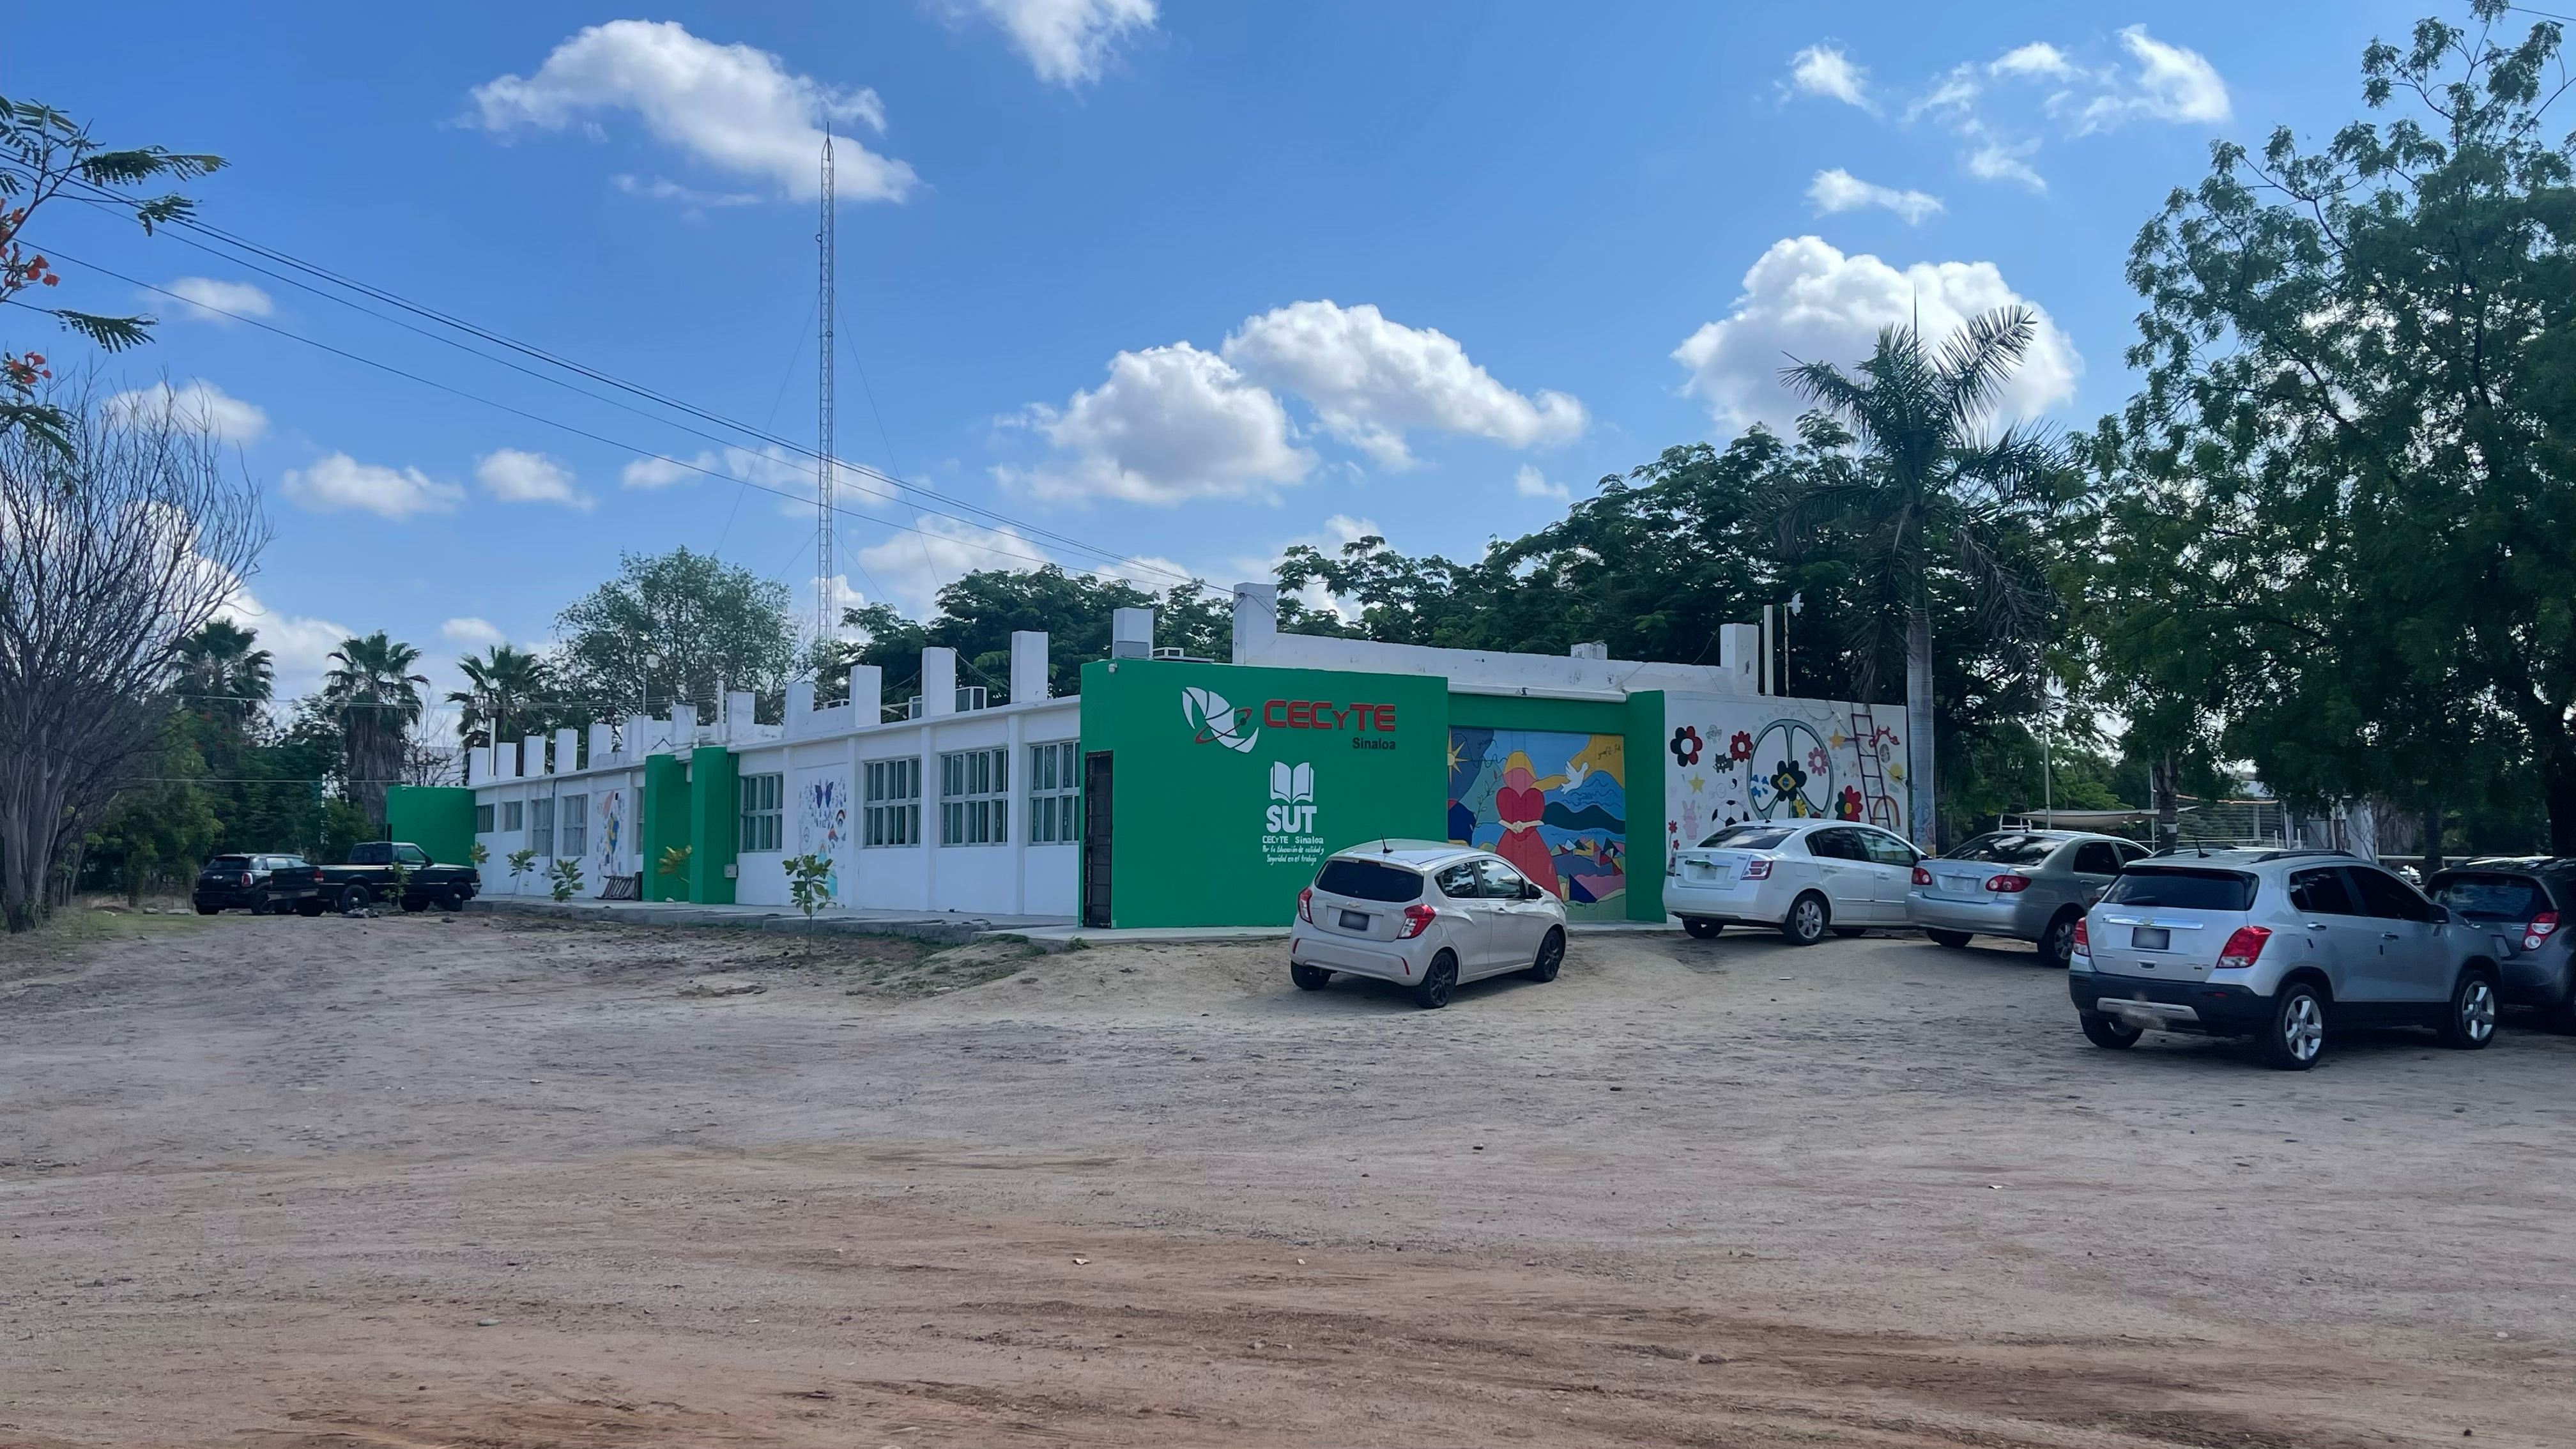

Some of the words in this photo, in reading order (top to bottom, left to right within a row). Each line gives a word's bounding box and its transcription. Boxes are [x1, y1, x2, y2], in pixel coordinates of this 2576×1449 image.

[1352, 737, 1396, 750] Sinaloa
[1266, 805, 1317, 833] SUT
[1294, 836, 1324, 845] Sinaloa
[1270, 845, 1276, 853] la
[1294, 854, 1301, 862] el
